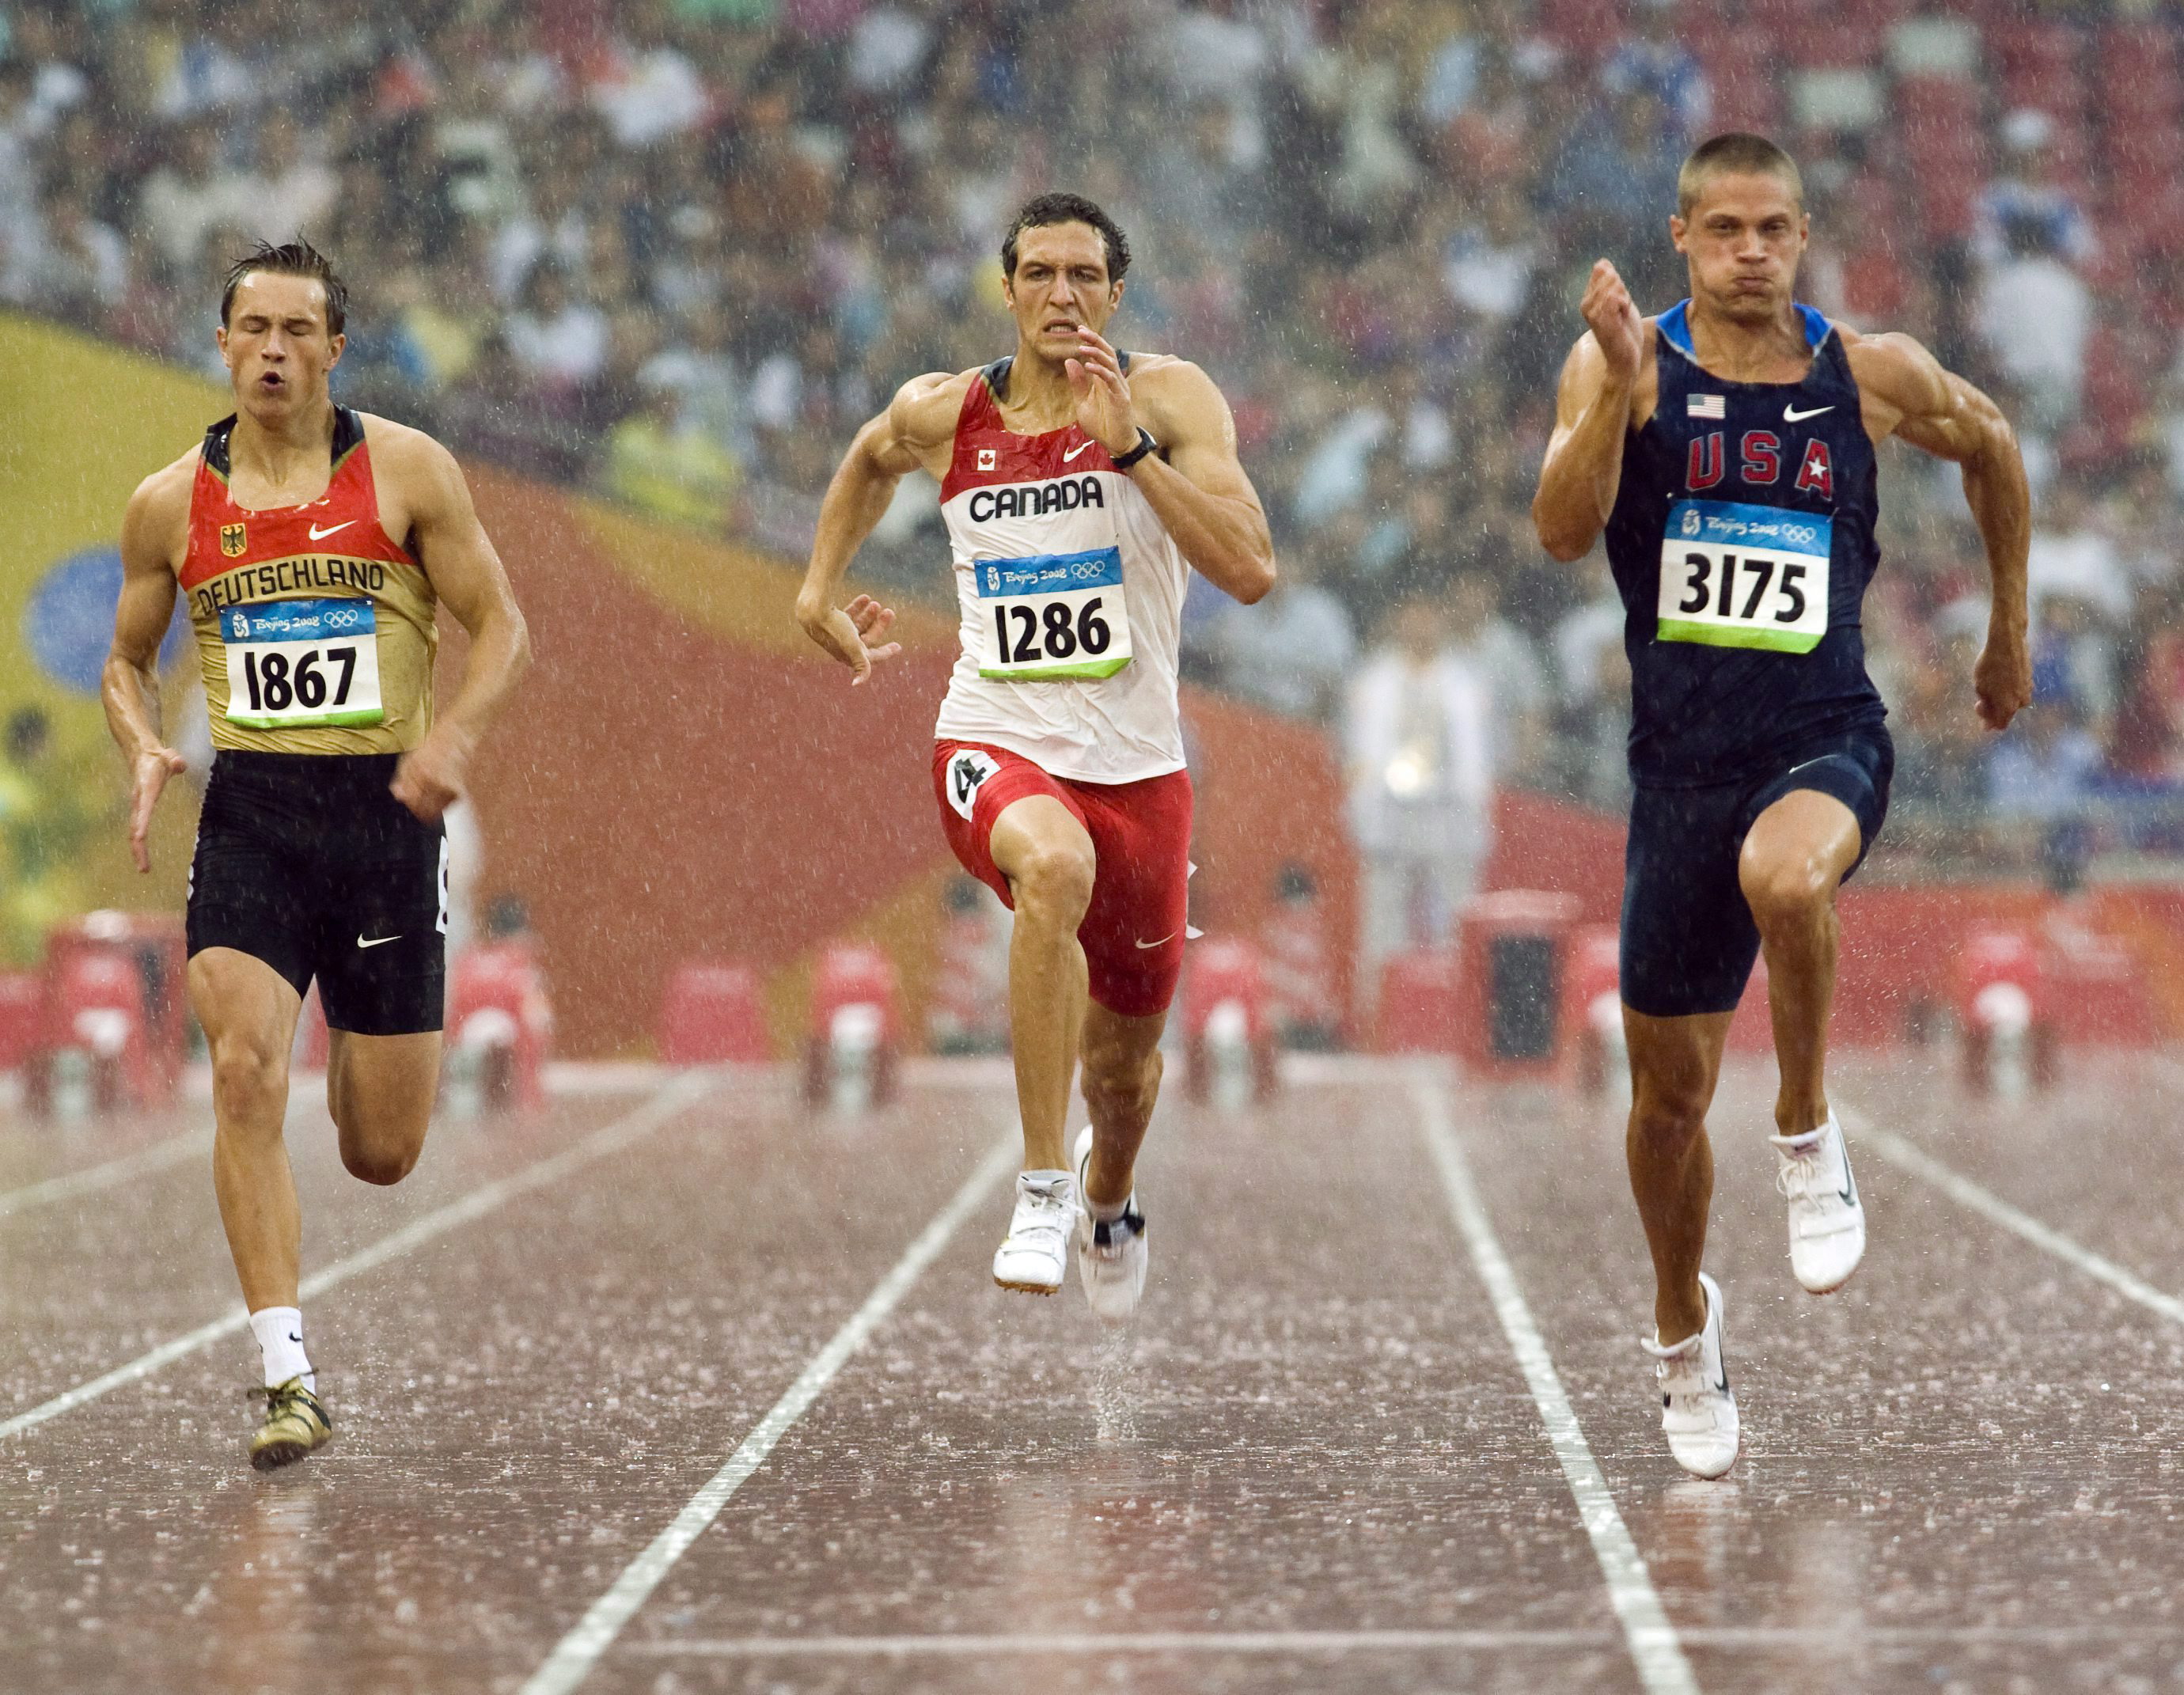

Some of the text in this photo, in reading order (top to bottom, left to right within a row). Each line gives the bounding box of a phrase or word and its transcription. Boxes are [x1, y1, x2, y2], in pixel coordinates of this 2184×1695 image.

[1685, 430, 1833, 502] USA
[969, 476, 1104, 522] CANADA
[1705, 516, 1779, 536] Beijing 2008
[197, 559, 385, 616] DEUTSCHLAND
[1002, 567, 1067, 584] Beijing 2008
[1679, 552, 1807, 623] 3175
[252, 616, 320, 631] Beijing 2008
[995, 597, 1111, 664] 1286
[244, 647, 357, 711] 1867
